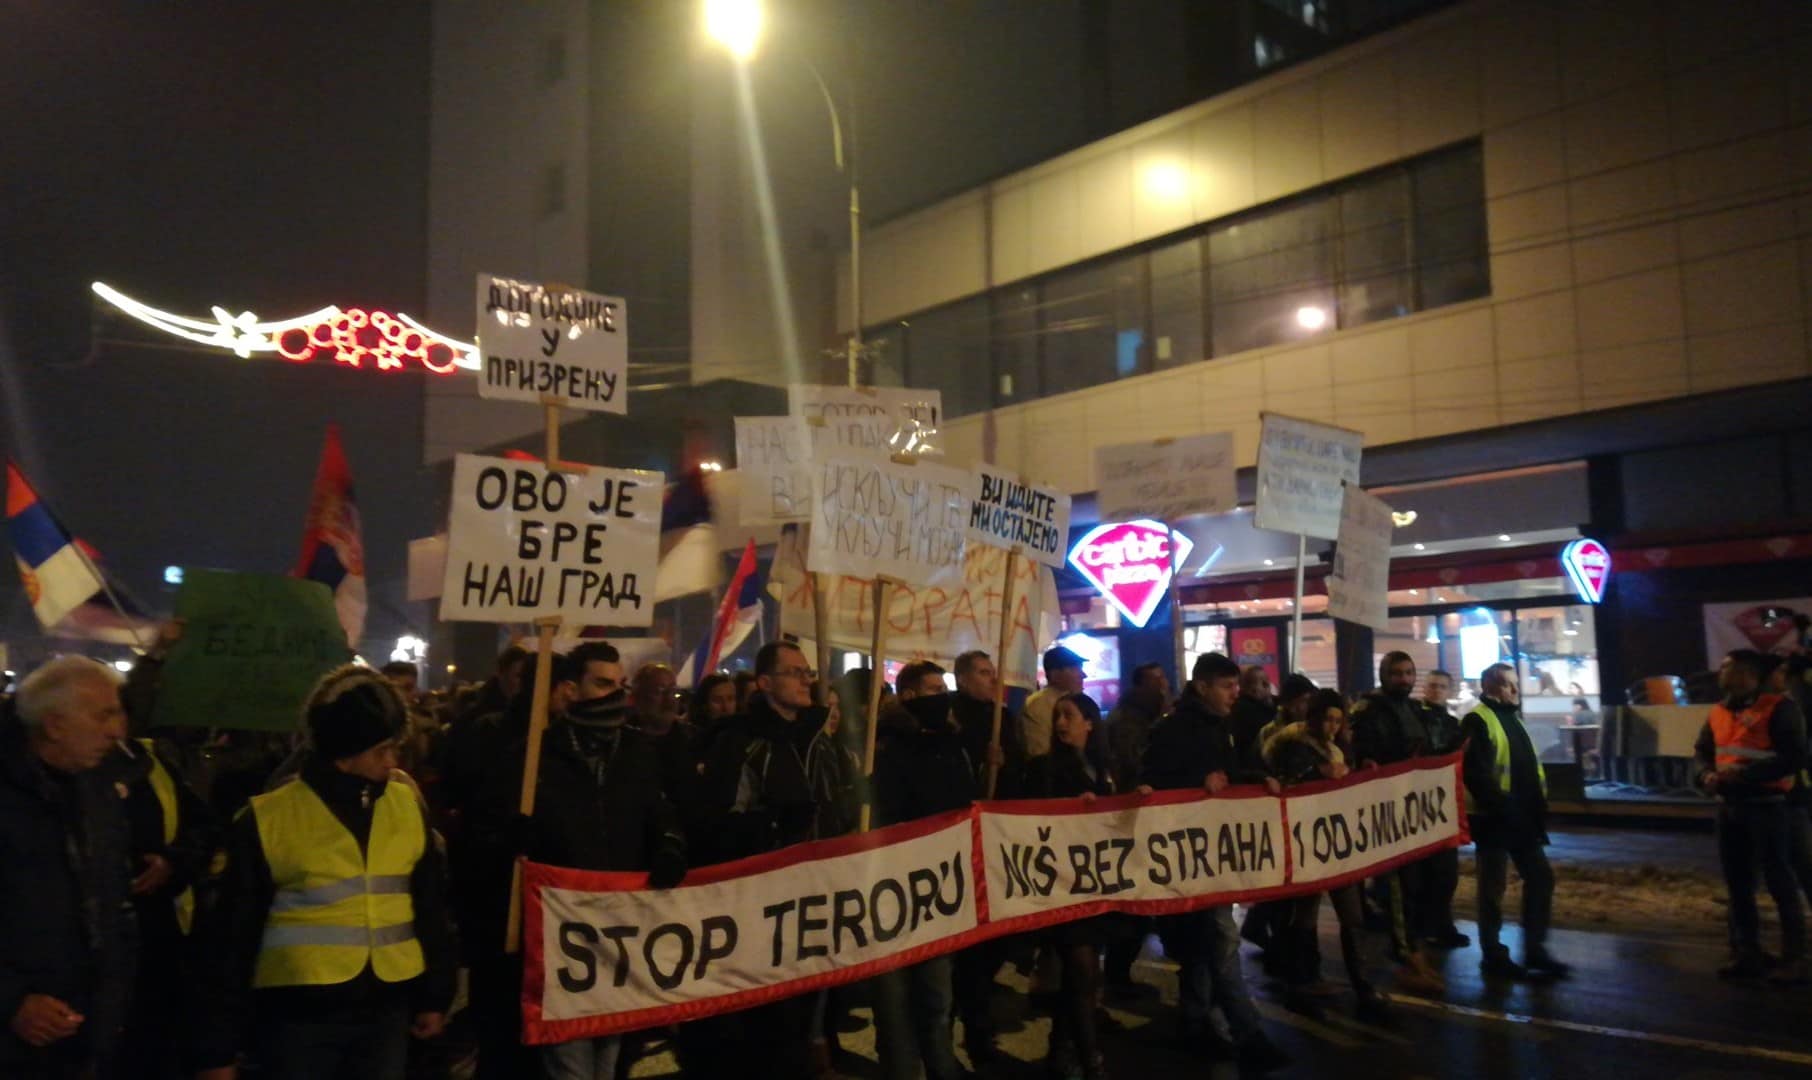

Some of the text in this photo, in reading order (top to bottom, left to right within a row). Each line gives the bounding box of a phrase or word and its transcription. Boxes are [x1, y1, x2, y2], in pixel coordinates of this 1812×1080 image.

[541, 328, 560, 356] У
[486, 356, 617, 401] ПРИЗРЕНУ
[475, 466, 639, 518] ОВО ЈЕ
[980, 472, 1003, 506] ВИ
[518, 520, 608, 565] БРЕ
[969, 500, 991, 533] МИ
[991, 507, 1060, 555] ОСТАЈЕМО
[461, 561, 641, 609] НАШ ГРАД
[999, 819, 1276, 900] NIŠ BEZ STRAHA
[1312, 811, 1353, 864] OD
[1355, 807, 1369, 853] 5
[556, 915, 738, 994] STOP
